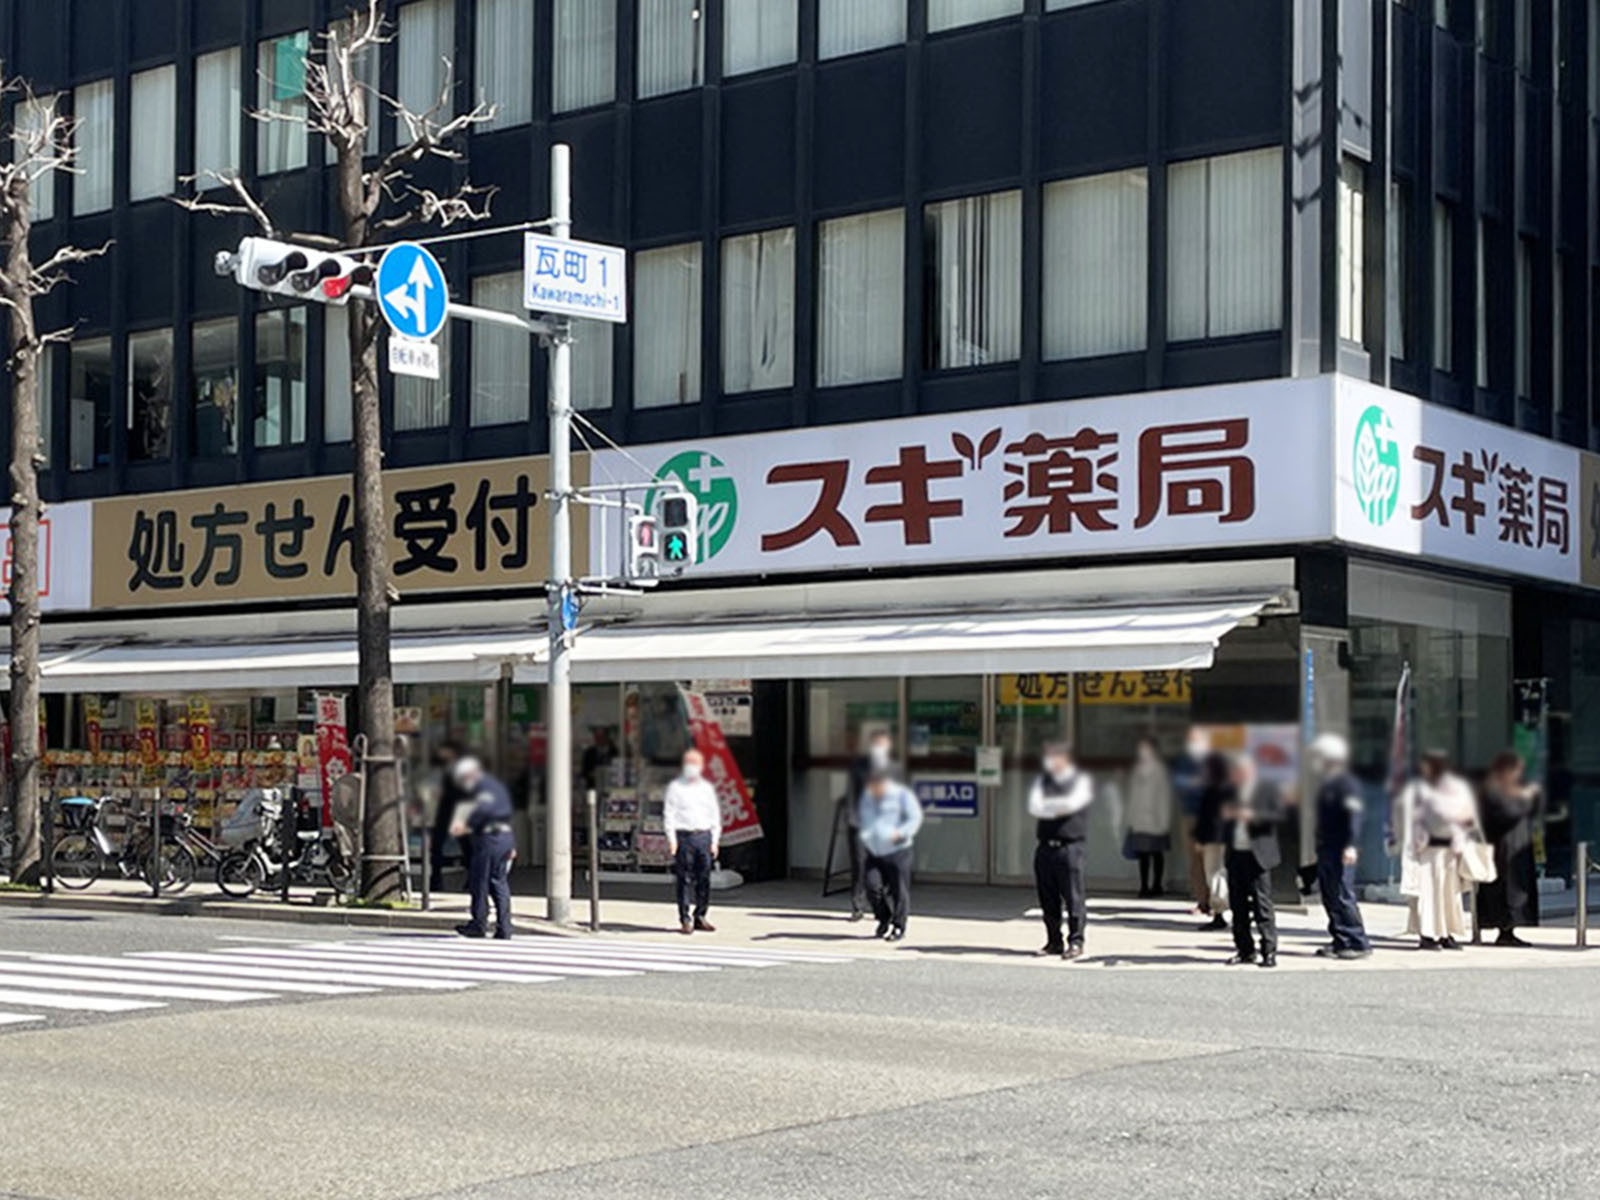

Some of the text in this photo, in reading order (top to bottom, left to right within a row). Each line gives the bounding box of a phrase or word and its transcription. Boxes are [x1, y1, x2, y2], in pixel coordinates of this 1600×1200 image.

[532, 284, 619, 310] Kawaramachi-1
[760, 417, 1256, 552] スギ薬局
[1411, 445, 1570, 556] スギ薬局
